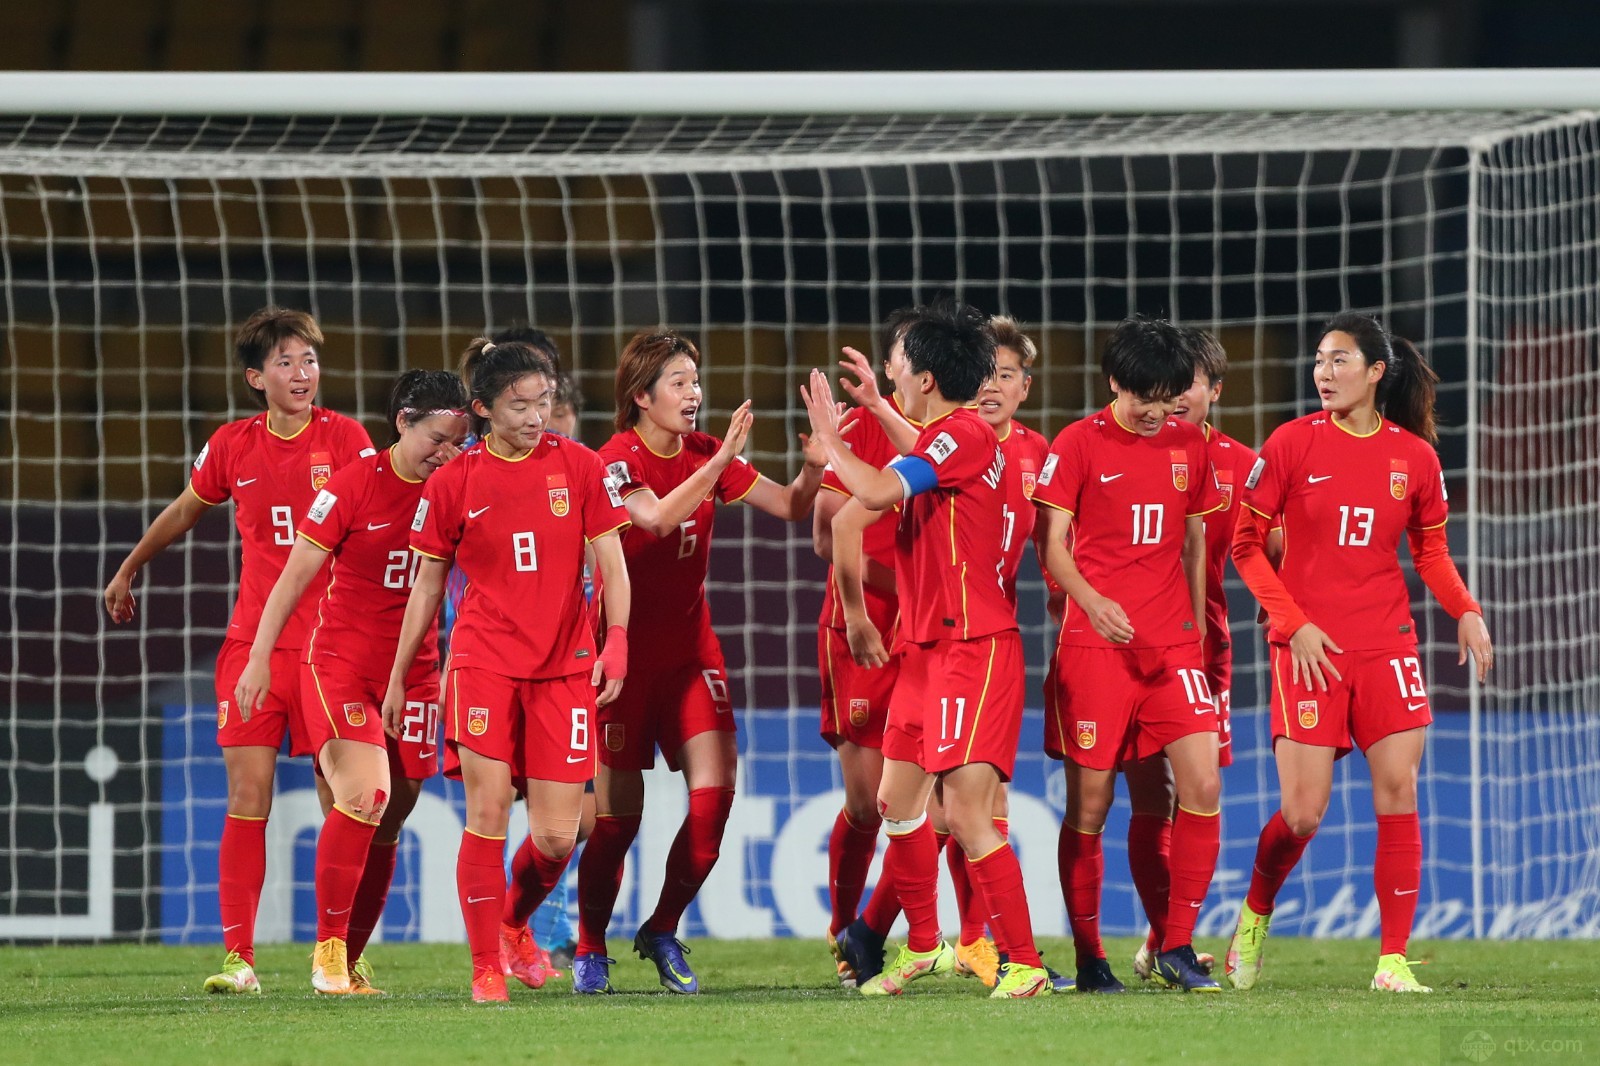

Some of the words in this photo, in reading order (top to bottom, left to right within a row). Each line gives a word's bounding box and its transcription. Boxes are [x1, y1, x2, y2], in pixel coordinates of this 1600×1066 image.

[551, 490, 567, 498] CFA
[271, 506, 294, 546] 9
[677, 519, 697, 560] 6
[1131, 504, 1164, 545] 10
[1338, 505, 1375, 546] 13
[512, 531, 538, 572] 8
[702, 669, 729, 703] 6
[1177, 668, 1214, 706] 10
[1389, 656, 1427, 699] 13
[402, 700, 439, 746] 20
[570, 707, 589, 751] 8
[940, 697, 966, 740] 11
